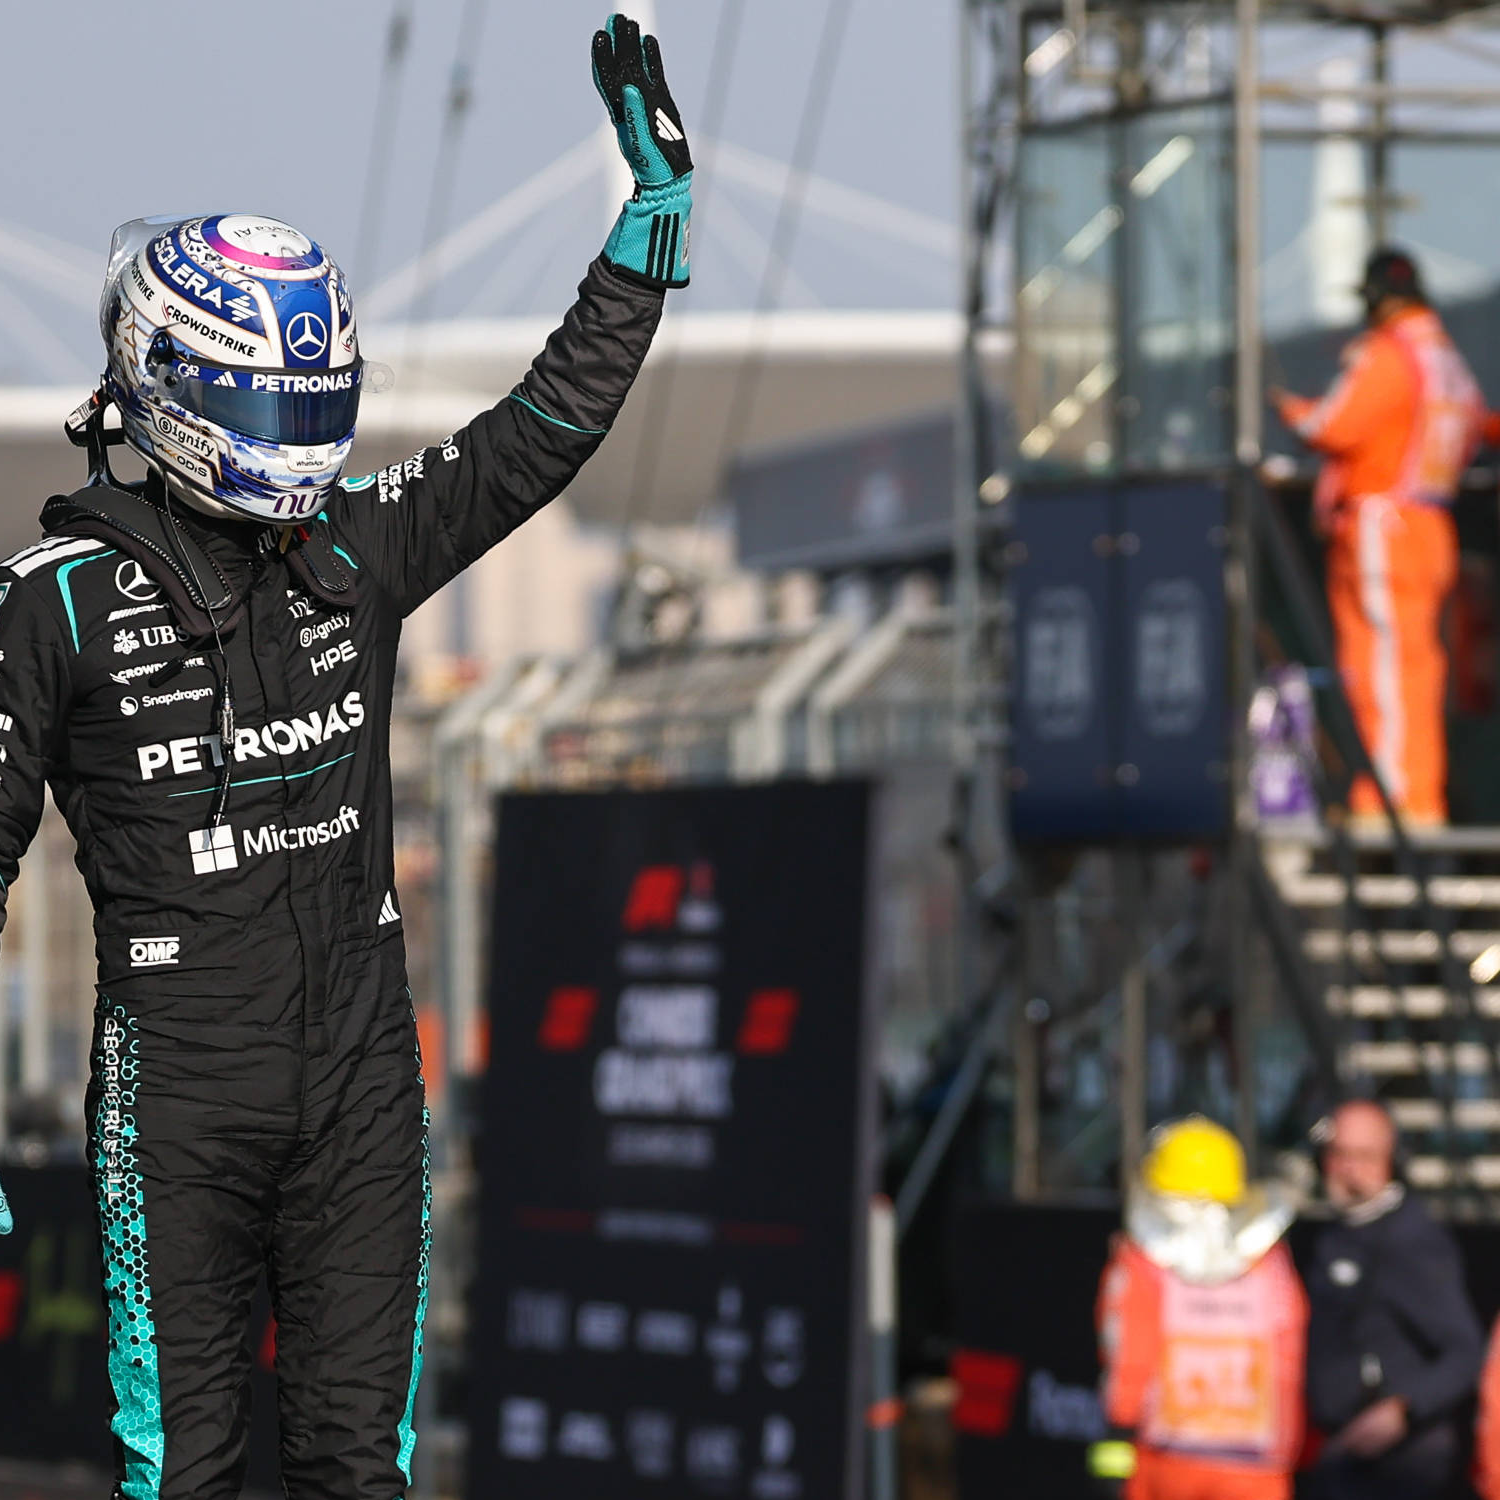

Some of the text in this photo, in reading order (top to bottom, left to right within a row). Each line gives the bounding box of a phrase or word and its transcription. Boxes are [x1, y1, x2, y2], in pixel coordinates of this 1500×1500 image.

[625, 107, 641, 154] WhatsApp
[154, 235, 222, 310] SOLERA
[166, 305, 257, 358] CROWDSTRIKE
[177, 363, 200, 378] G42
[251, 372, 352, 393] PETRONAS
[140, 625, 190, 647] UBS
[310, 639, 358, 676] HPE
[142, 687, 213, 708] Snapdragon
[138, 692, 365, 780] PETRONAS
[243, 806, 360, 858] Microsoft
[130, 940, 180, 964] OMP
